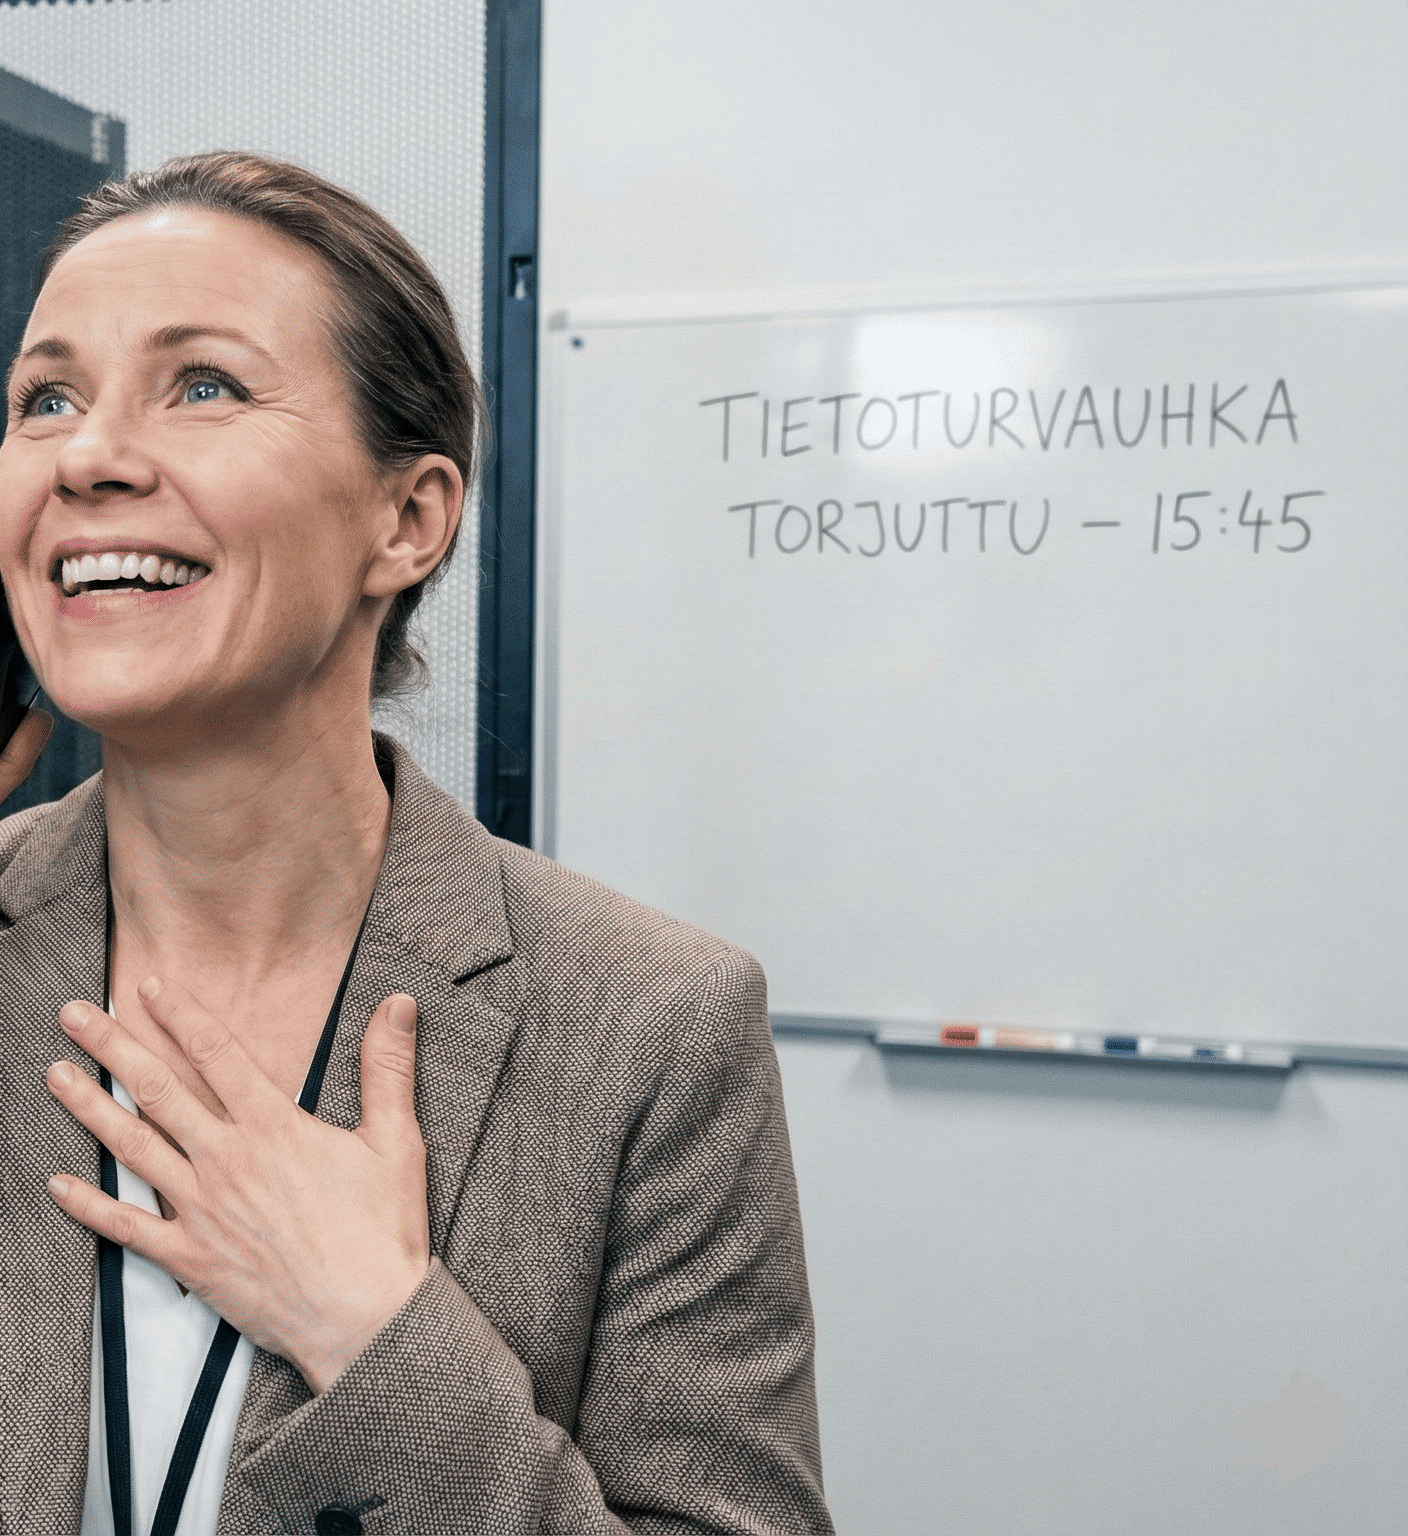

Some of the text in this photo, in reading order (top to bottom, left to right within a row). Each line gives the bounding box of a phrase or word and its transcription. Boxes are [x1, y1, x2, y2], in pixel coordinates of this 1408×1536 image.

[699, 377, 1300, 462] TIETOTURVAUHKA
[728, 498, 1051, 559] TORJUTTU
[1152, 489, 1326, 555] 15:45
